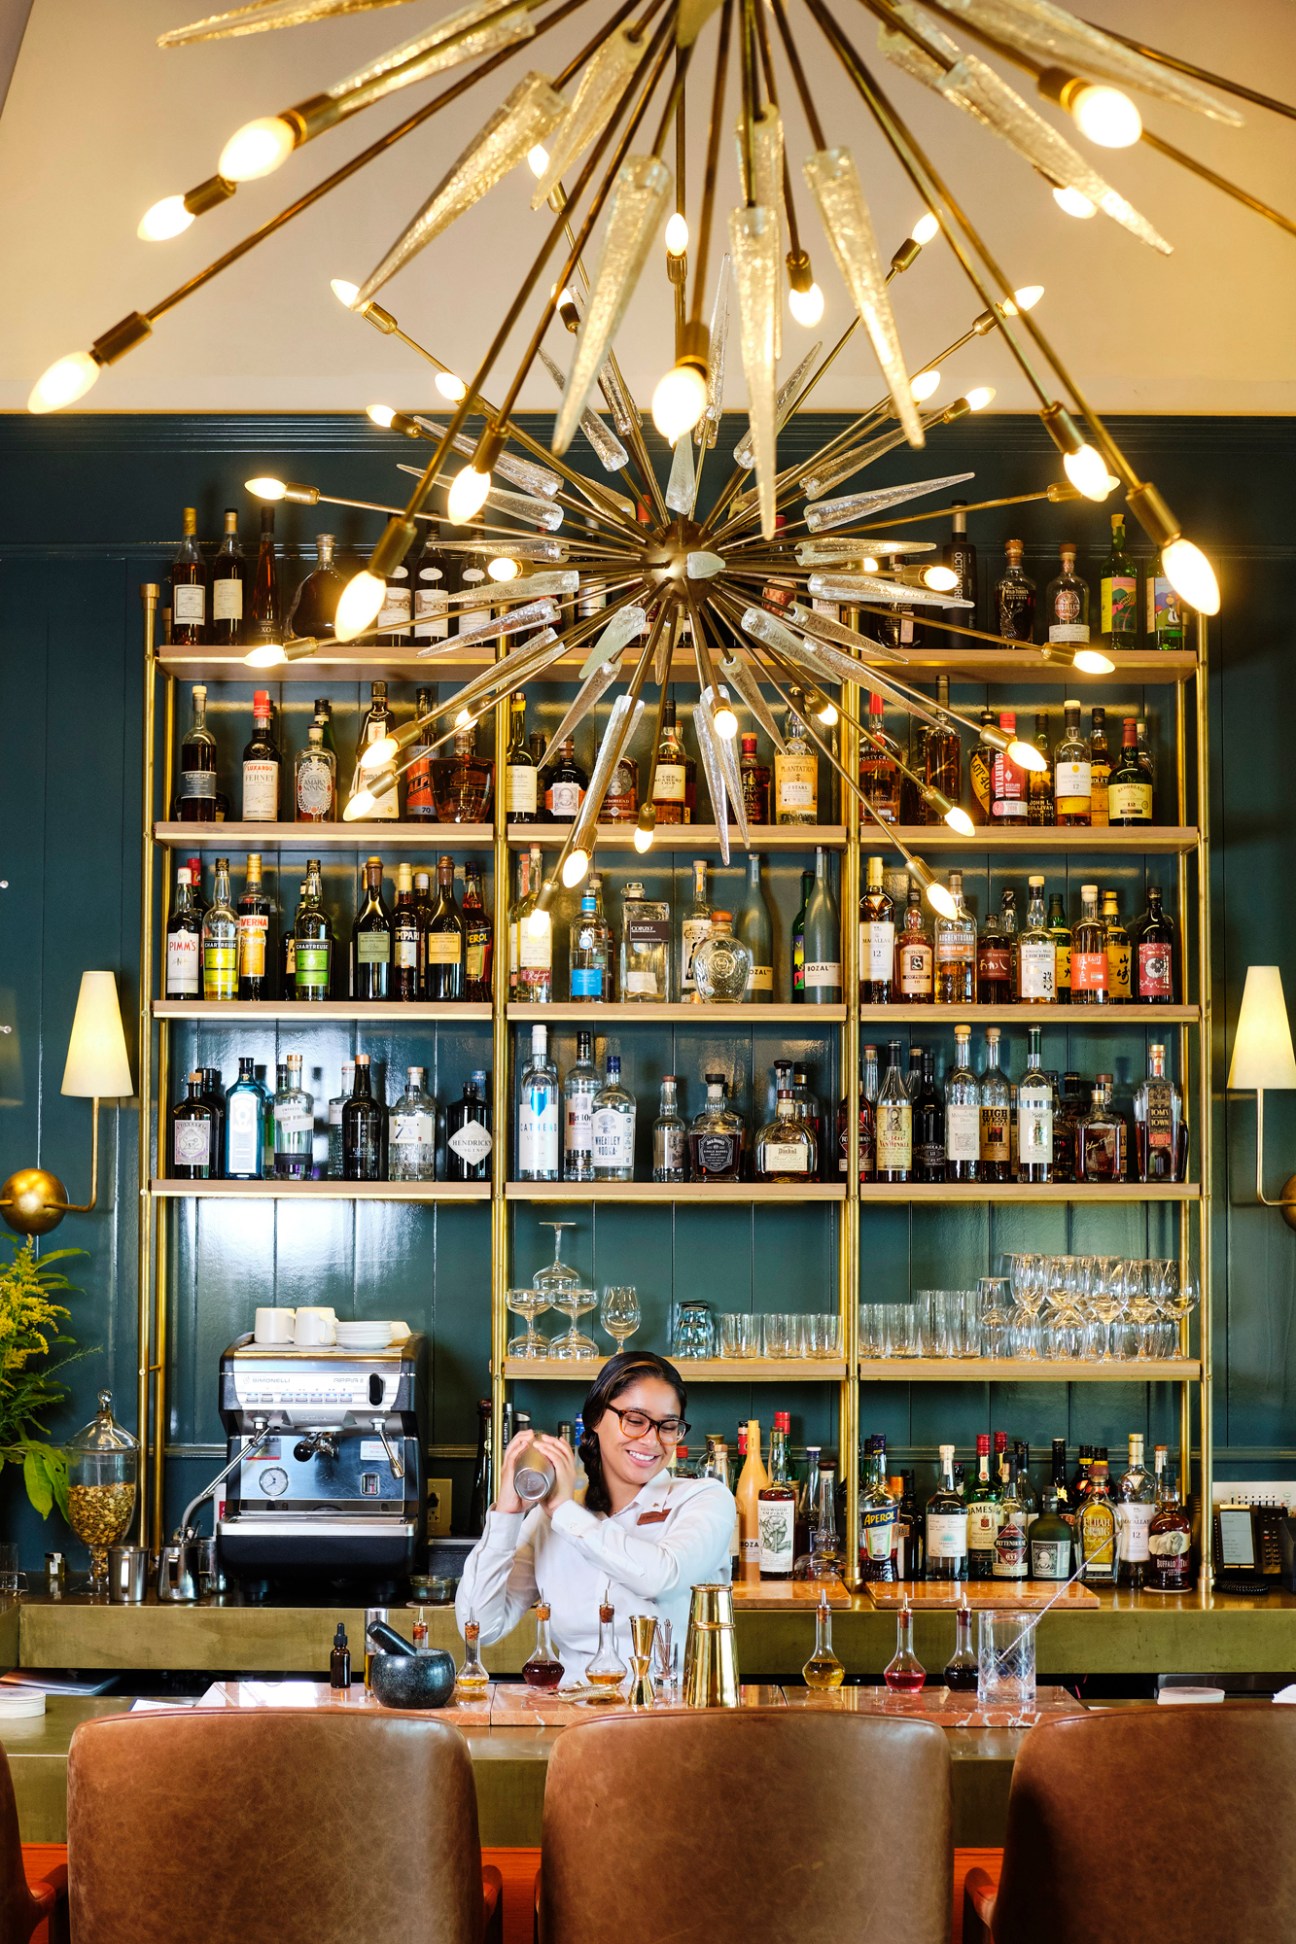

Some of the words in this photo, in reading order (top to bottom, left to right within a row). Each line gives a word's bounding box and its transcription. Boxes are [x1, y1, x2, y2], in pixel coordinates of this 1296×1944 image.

[246, 774, 274, 782] FERNET
[995, 753, 1004, 798] GARRYANA
[395, 931, 420, 941] MPARI
[469, 933, 488, 944] EROL
[169, 940, 196, 951] PIMM'S
[981, 1109, 1009, 1118] HIGH
[595, 1135, 621, 1146] WHEATLEY
[967, 1505, 993, 1516] JAMES
[864, 1506, 896, 1526] APEROL
[1083, 1517, 1111, 1527] ELIJAH
[1132, 1531, 1141, 1539] 12
[740, 1540, 760, 1548] BOZA
[1156, 1558, 1176, 1568] BUFFALO
